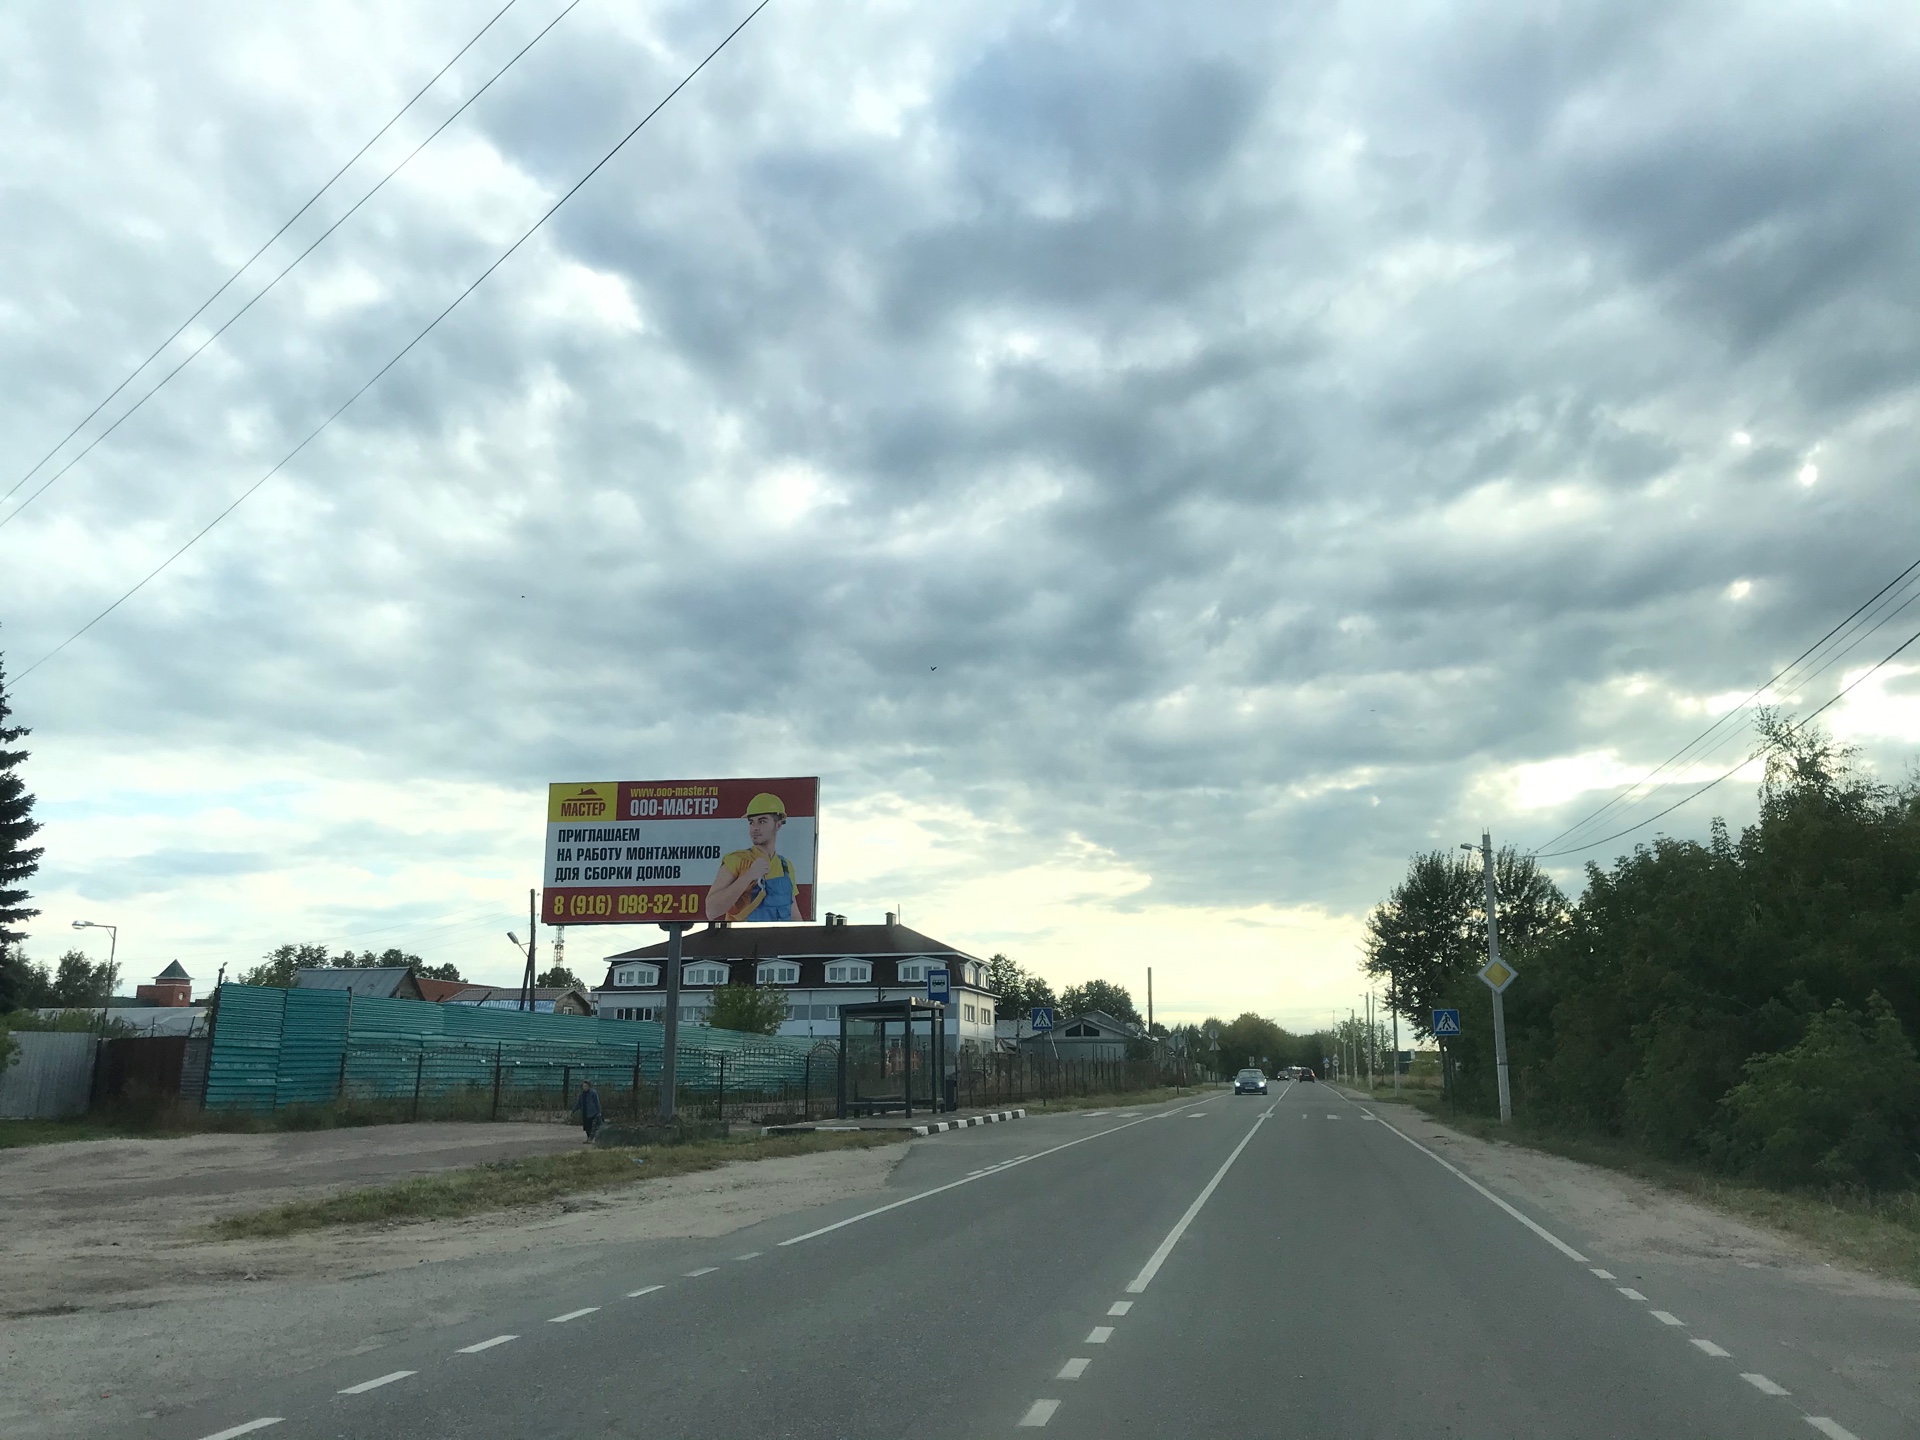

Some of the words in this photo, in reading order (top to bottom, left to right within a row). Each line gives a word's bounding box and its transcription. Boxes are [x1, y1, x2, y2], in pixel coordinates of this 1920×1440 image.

[631, 786, 718, 797] www.ooo-master.ru
[561, 803, 606, 817] МАСТЕР
[630, 798, 718, 816] ООО-МАСТЕР
[558, 828, 640, 842] ПРИГЛАШАЕМ
[557, 848, 572, 861] НА
[577, 847, 622, 861] РАБОТУ
[626, 845, 720, 860] МОНТАЖНИКОВ
[555, 867, 579, 882] ДЛЯ
[585, 866, 632, 880] СБОРКИ
[636, 865, 680, 881] ДОМОВ
[554, 896, 565, 915] 8
[570, 894, 612, 916] (916)
[619, 893, 699, 914] 098-32-10
